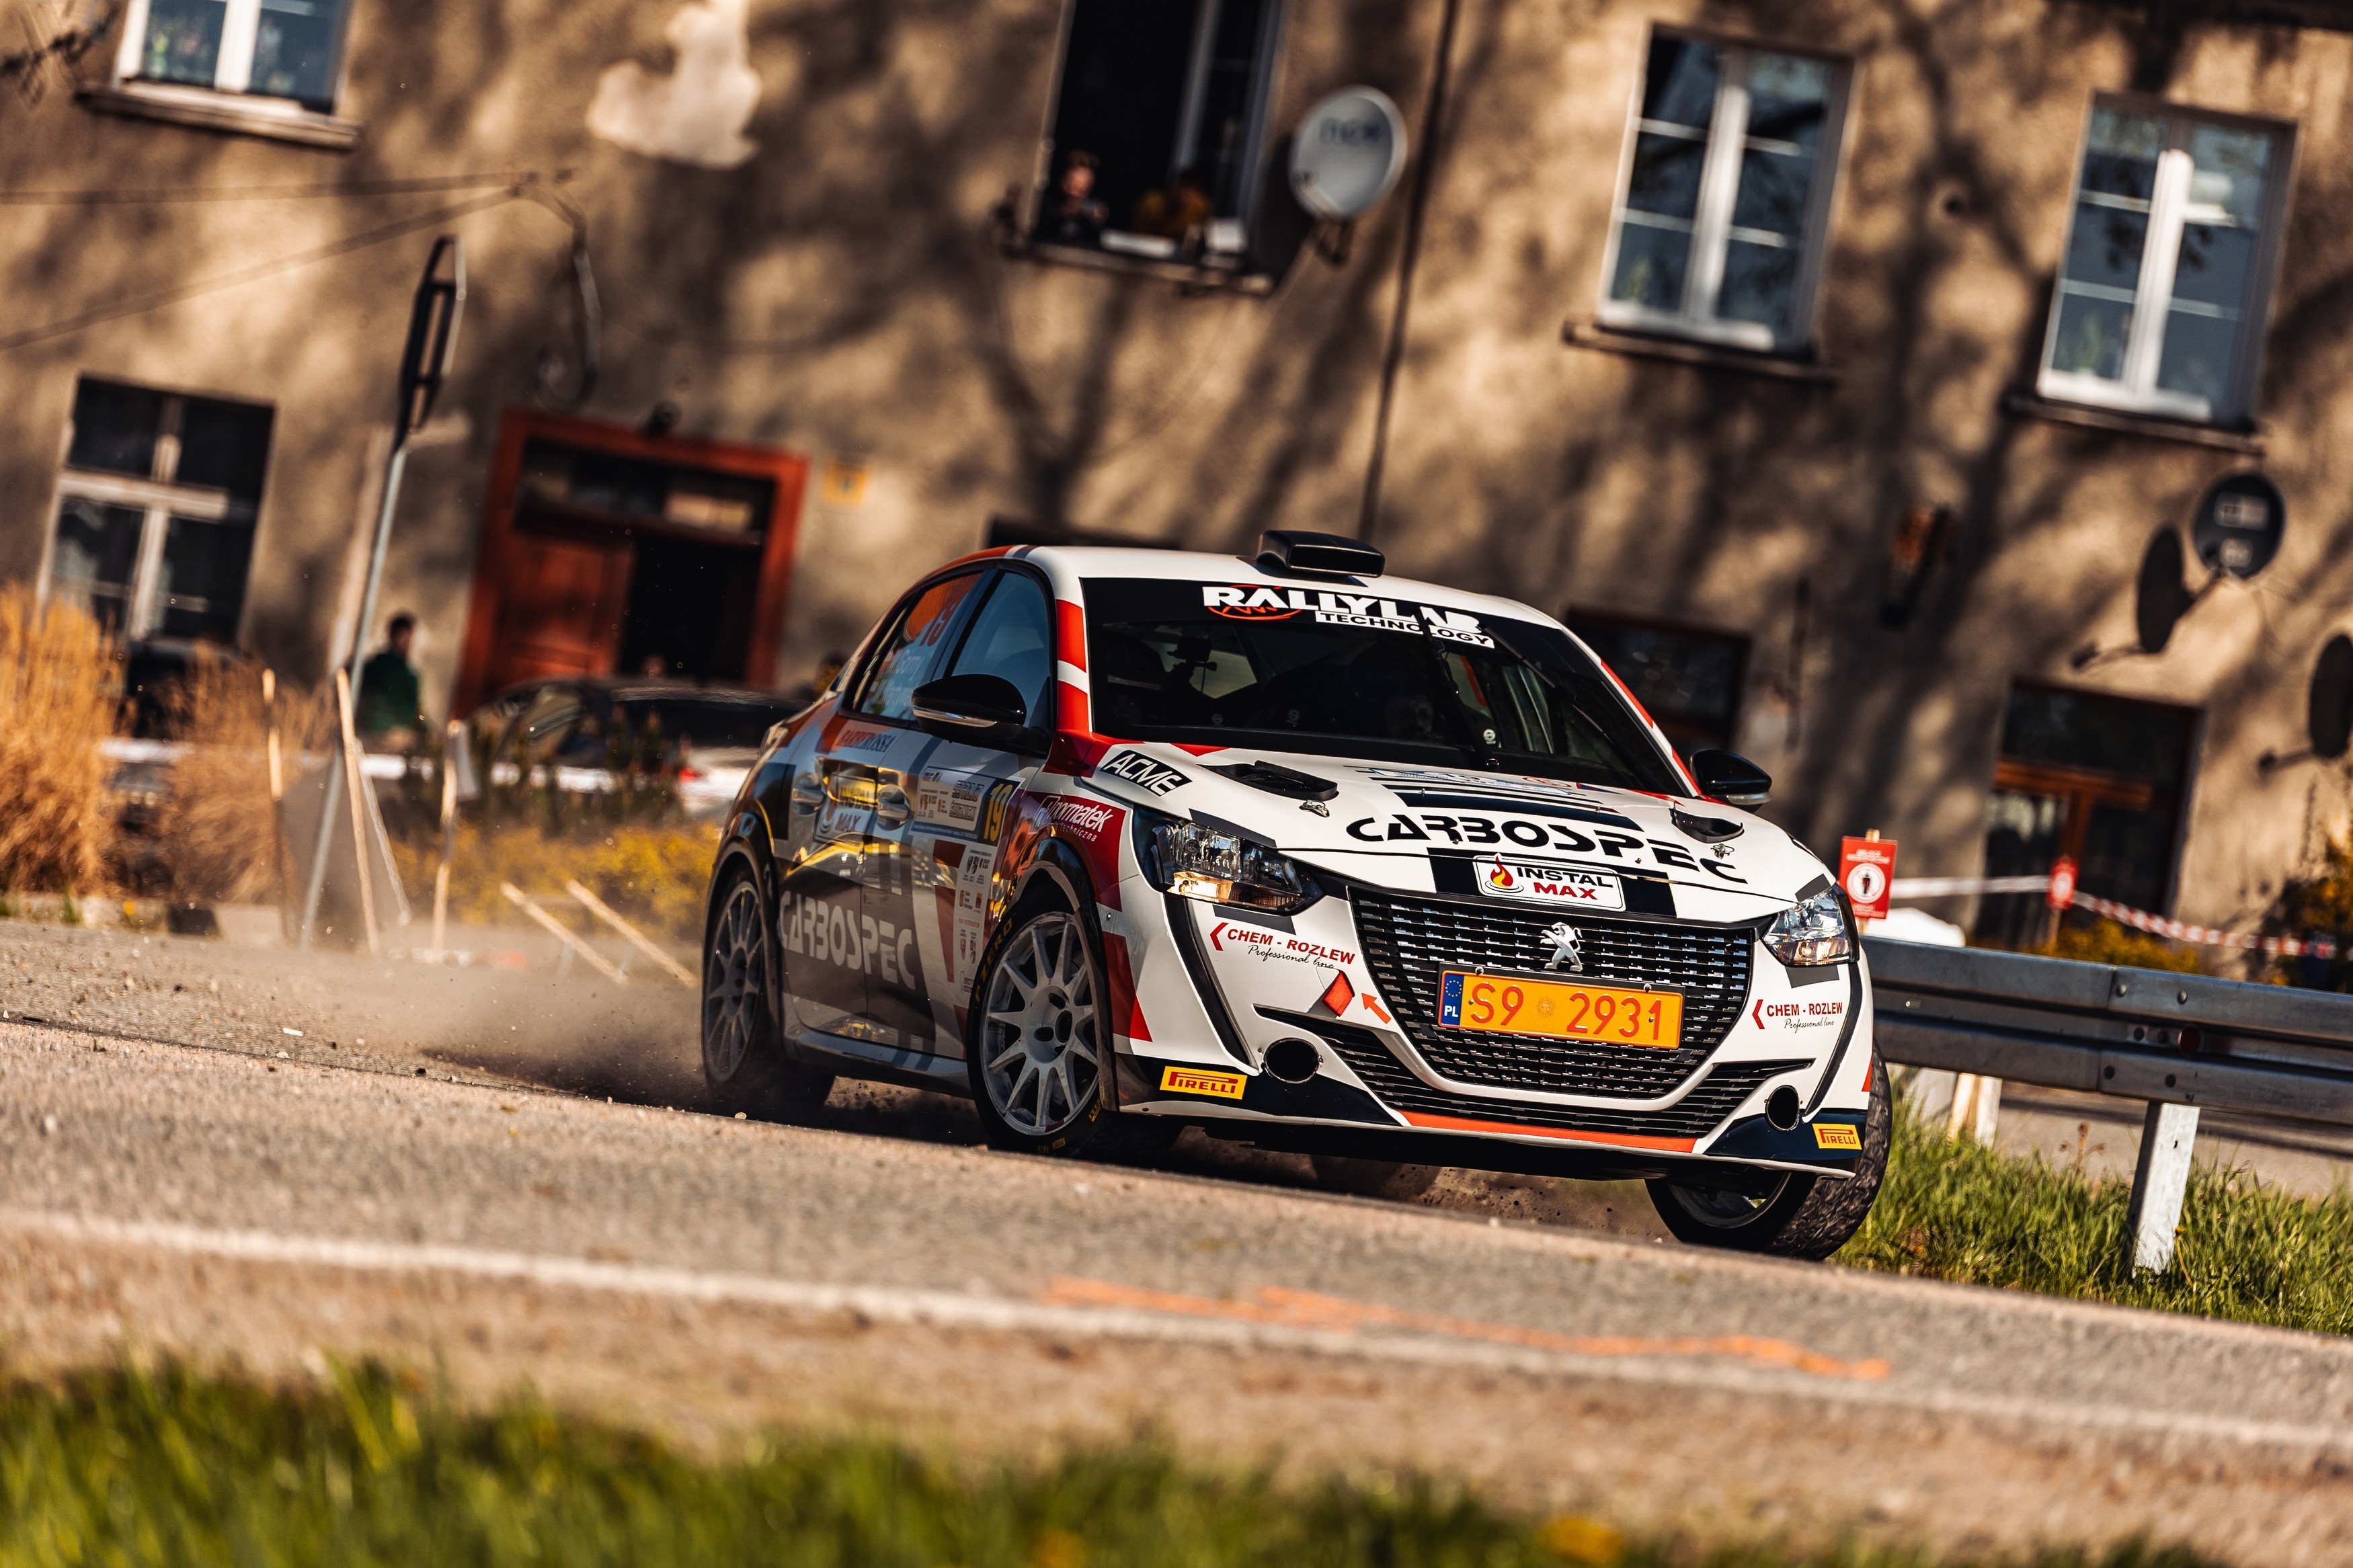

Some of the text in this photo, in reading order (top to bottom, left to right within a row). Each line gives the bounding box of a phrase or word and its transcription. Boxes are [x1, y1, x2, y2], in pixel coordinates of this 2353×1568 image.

[1203, 586, 1482, 634] RALLYLAB
[1320, 613, 1488, 645] TECHNOOGY
[1103, 753, 1183, 796] ACME
[834, 812, 861, 832] MAX
[984, 783, 1013, 841] 19
[1046, 801, 1114, 833] normatek
[1346, 814, 1748, 884] CARBOSPEC
[1517, 866, 1614, 888] INSTAL
[1533, 882, 1598, 900] MAX
[780, 890, 916, 990] CARBOSPEC
[1228, 928, 1273, 946] CHEM
[1287, 939, 1355, 964] ROZLEW
[1248, 944, 1334, 969] Professional line
[1445, 1005, 1458, 1018] PL
[1470, 982, 1662, 1040] S9 2931
[1767, 1004, 1800, 1017] CHEM
[1808, 1002, 1843, 1016] ROZLEW
[1784, 1016, 1835, 1034] Professional line
[1168, 1071, 1238, 1094] PIRELLI
[1819, 1128, 1856, 1145] PIRELLI
